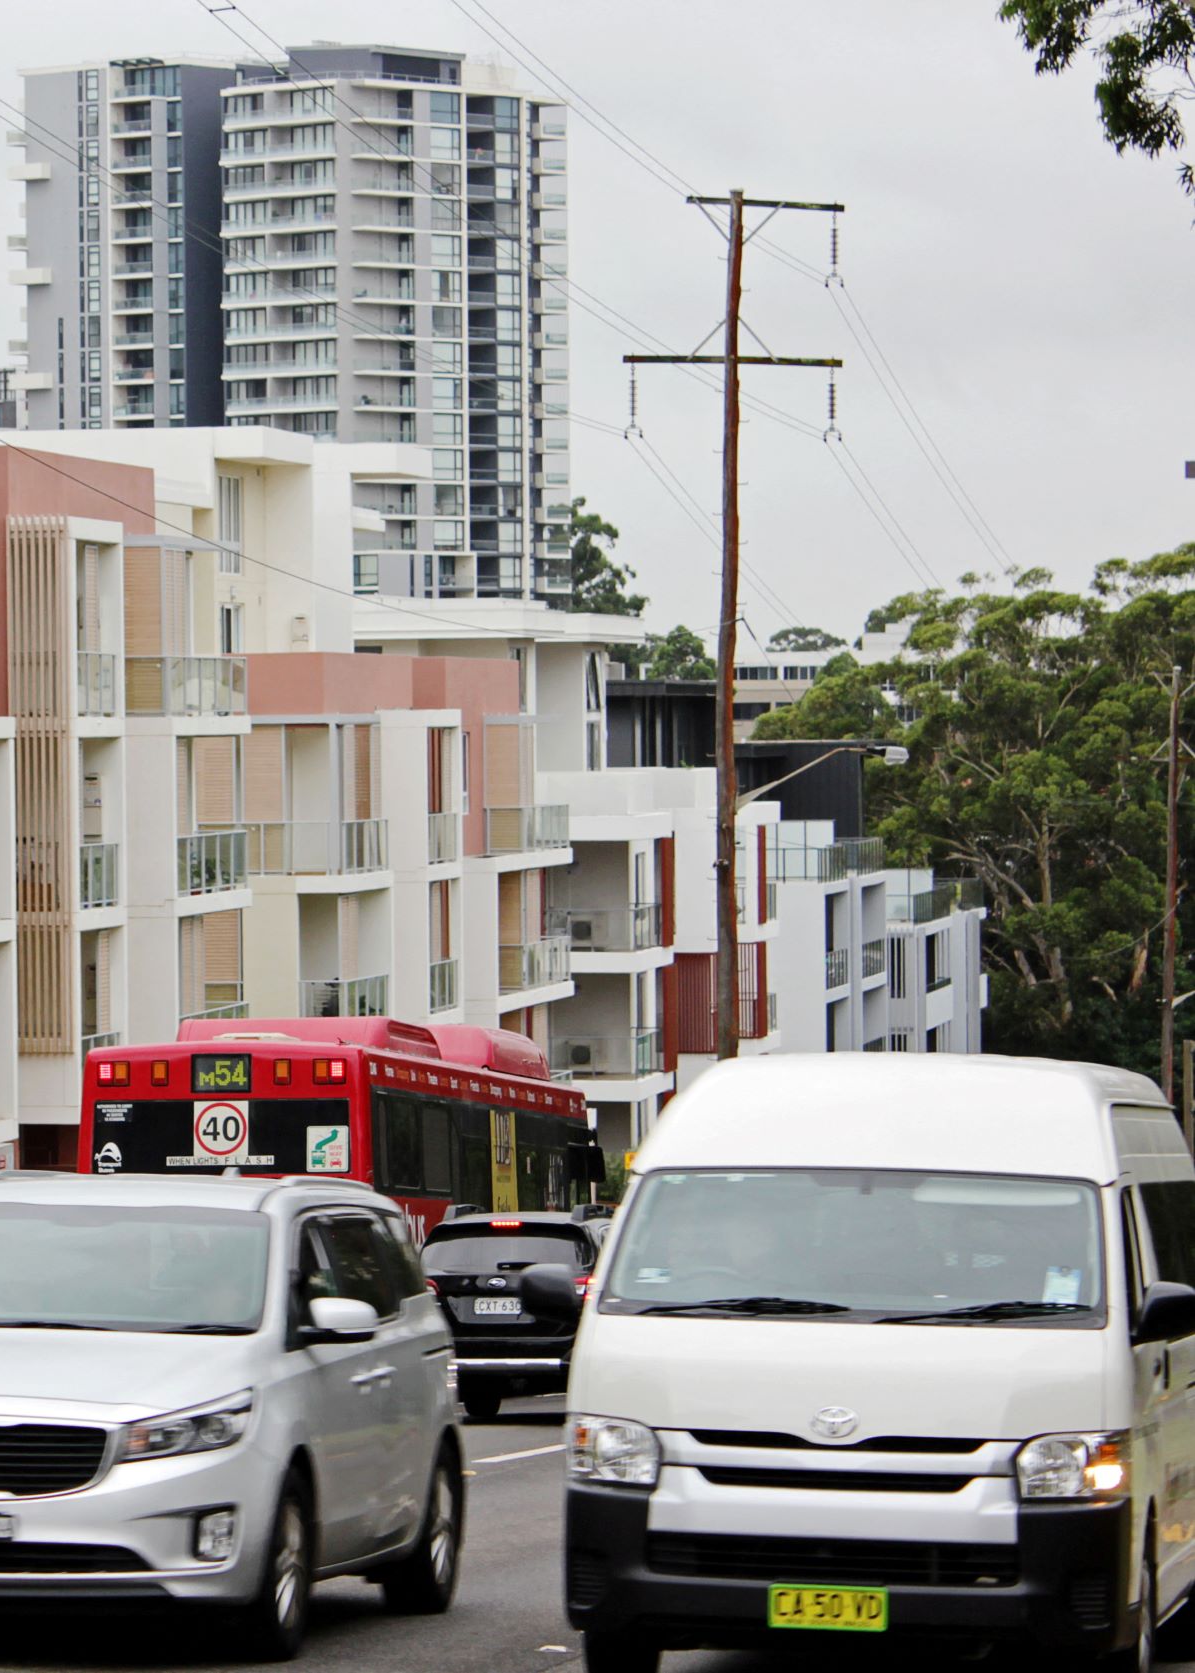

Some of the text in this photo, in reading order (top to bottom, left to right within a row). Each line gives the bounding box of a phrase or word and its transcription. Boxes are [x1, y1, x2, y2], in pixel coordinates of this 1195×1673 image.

[202, 1116, 241, 1141] 40
[168, 1157, 191, 1165] WHEN
[193, 1157, 219, 1165] LIGHTS
[478, 1300, 498, 1312] CXT
